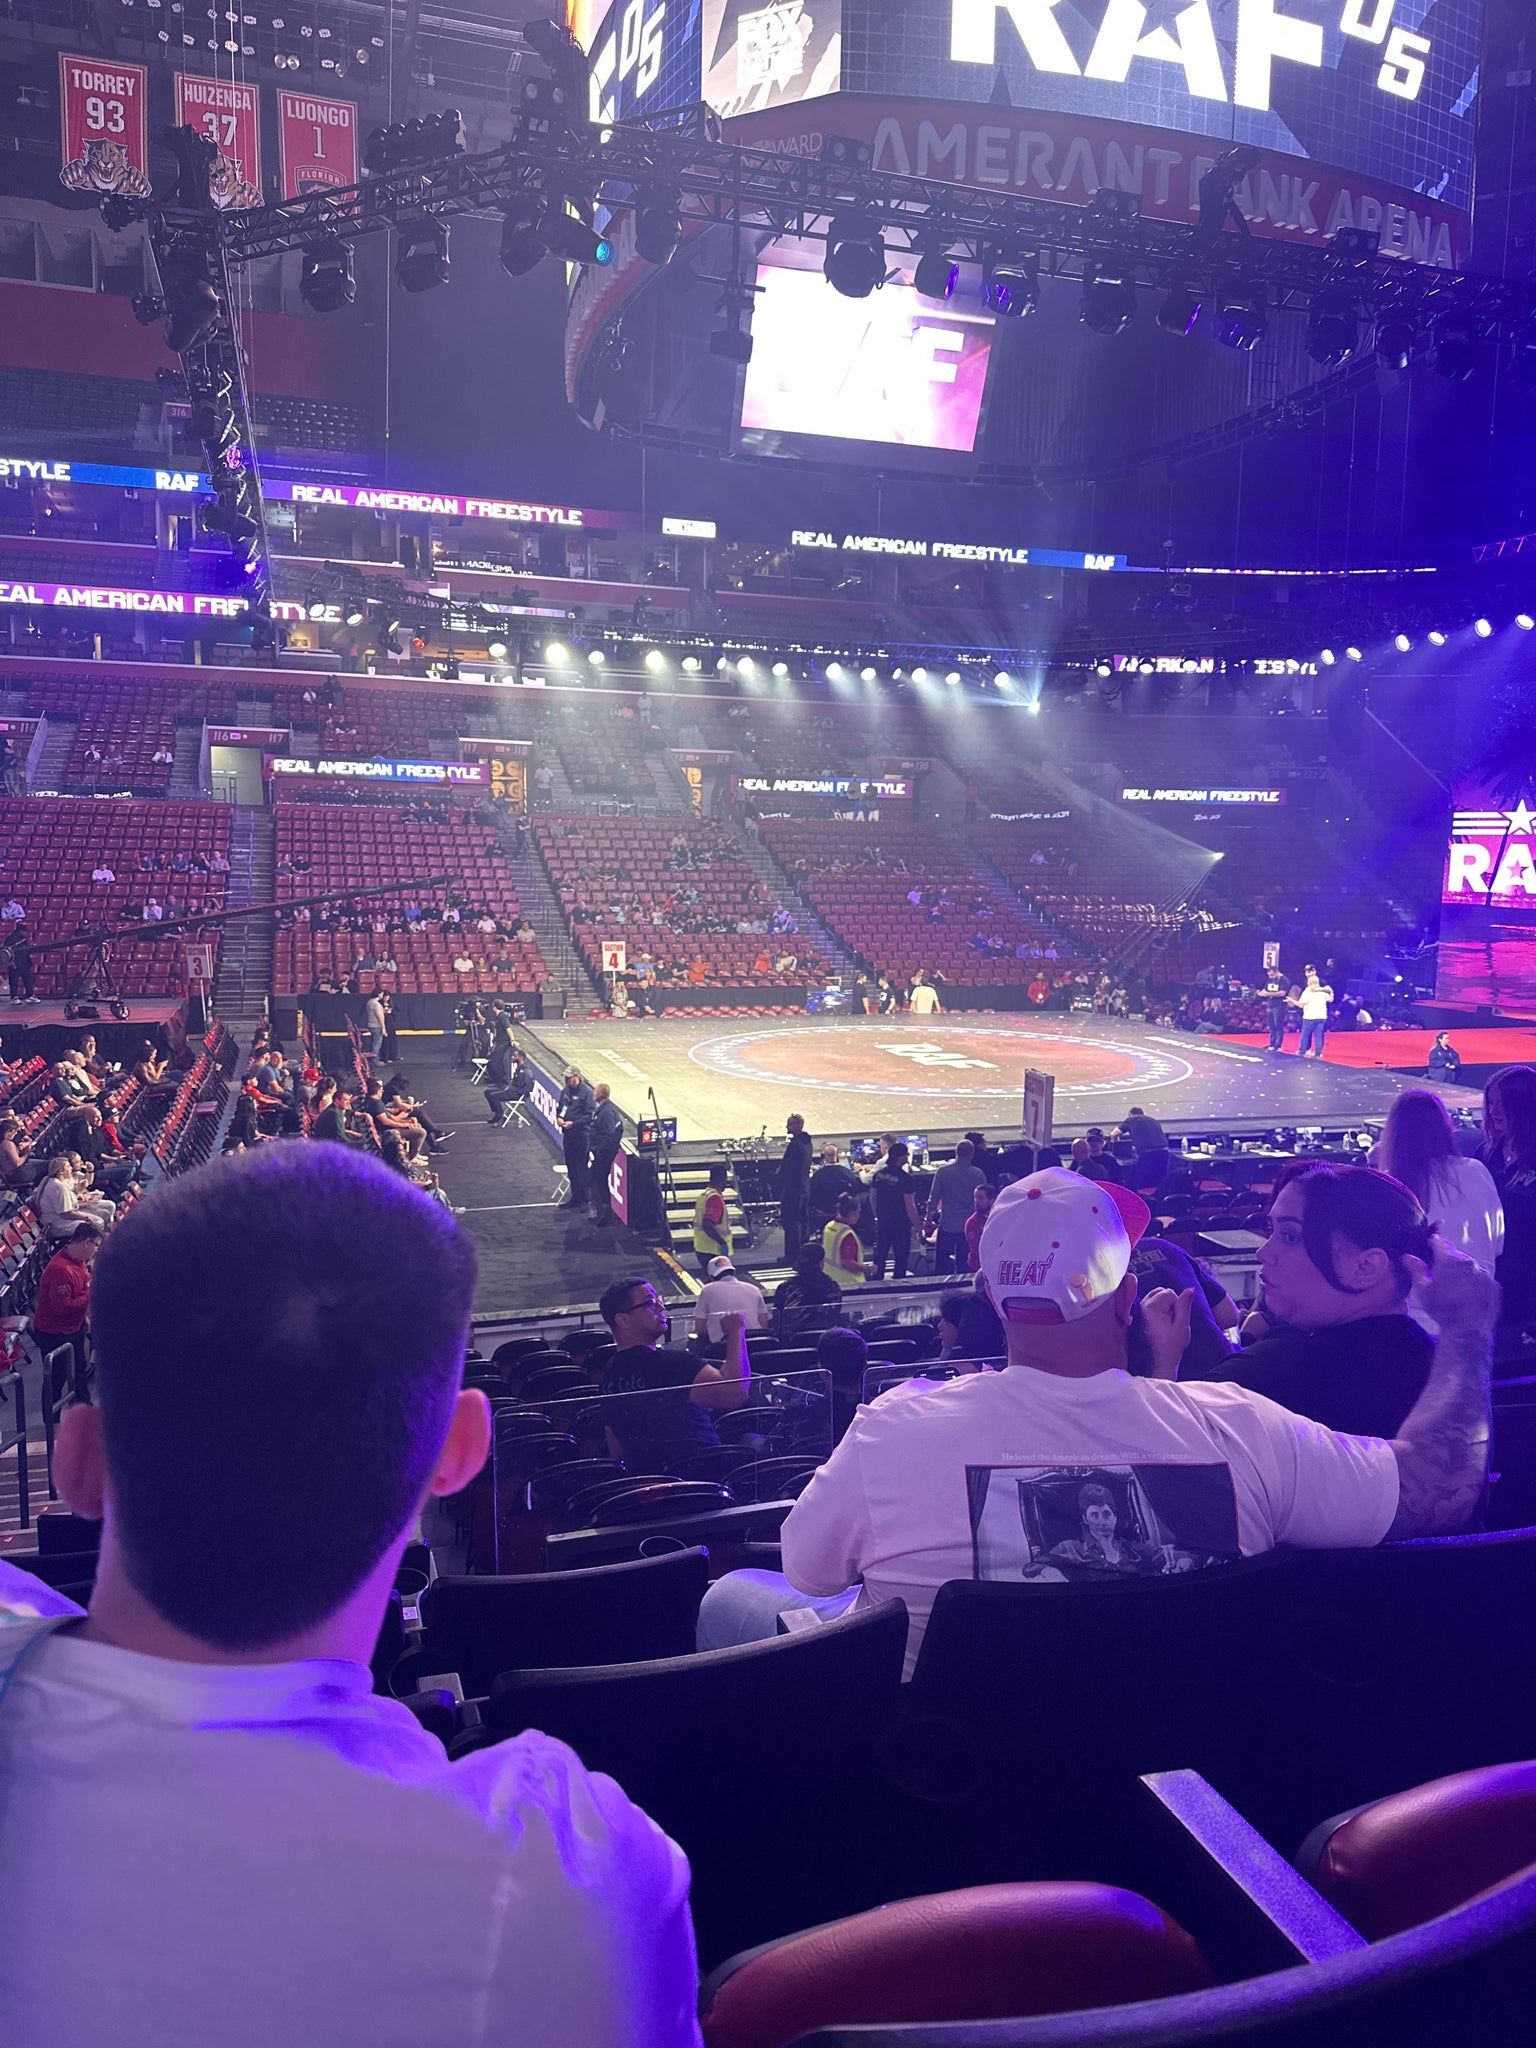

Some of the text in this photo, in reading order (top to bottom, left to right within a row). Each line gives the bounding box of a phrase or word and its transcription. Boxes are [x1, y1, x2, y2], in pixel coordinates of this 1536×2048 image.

[71, 68, 135, 97] TORREY
[184, 82, 251, 111] HUIZENGA
[85, 96, 125, 133] 93
[286, 99, 349, 127] LUONGO
[202, 112, 238, 146] 37
[313, 126, 327, 159] 1
[301, 171, 341, 185] FLORIDA
[873, 117, 1182, 206] AMERANT
[1322, 188, 1456, 268] ARENA
[172, 407, 186, 417] 316
[156, 472, 198, 491] RAF
[292, 485, 583, 525] REAL AMERICAN FREESTYLE
[792, 530, 1115, 571] REAL AMERICAN FREESTYLE RAF
[53, 588, 184, 613] AMERICAN
[214, 731, 284, 744] 116 117
[464, 743, 528, 756] 117 118
[717, 754, 730, 764] 119
[273, 758, 315, 774] REAL
[317, 760, 392, 776] AMERICAN
[773, 779, 833, 792] AMERICAN
[1122, 788, 1280, 802] REAL AMERICAN FREESTYLE
[193, 956, 203, 976] 3
[609, 953, 619, 968] 4
[1266, 952, 1273, 968] 5
[873, 1043, 999, 1069] RAF
[1031, 1099, 1040, 1140] 7
[998, 1252, 1055, 1286] HEAT
[1002, 1452, 1014, 1461] He
[1038, 1452, 1051, 1462] the
[1052, 1452, 1090, 1463] American
